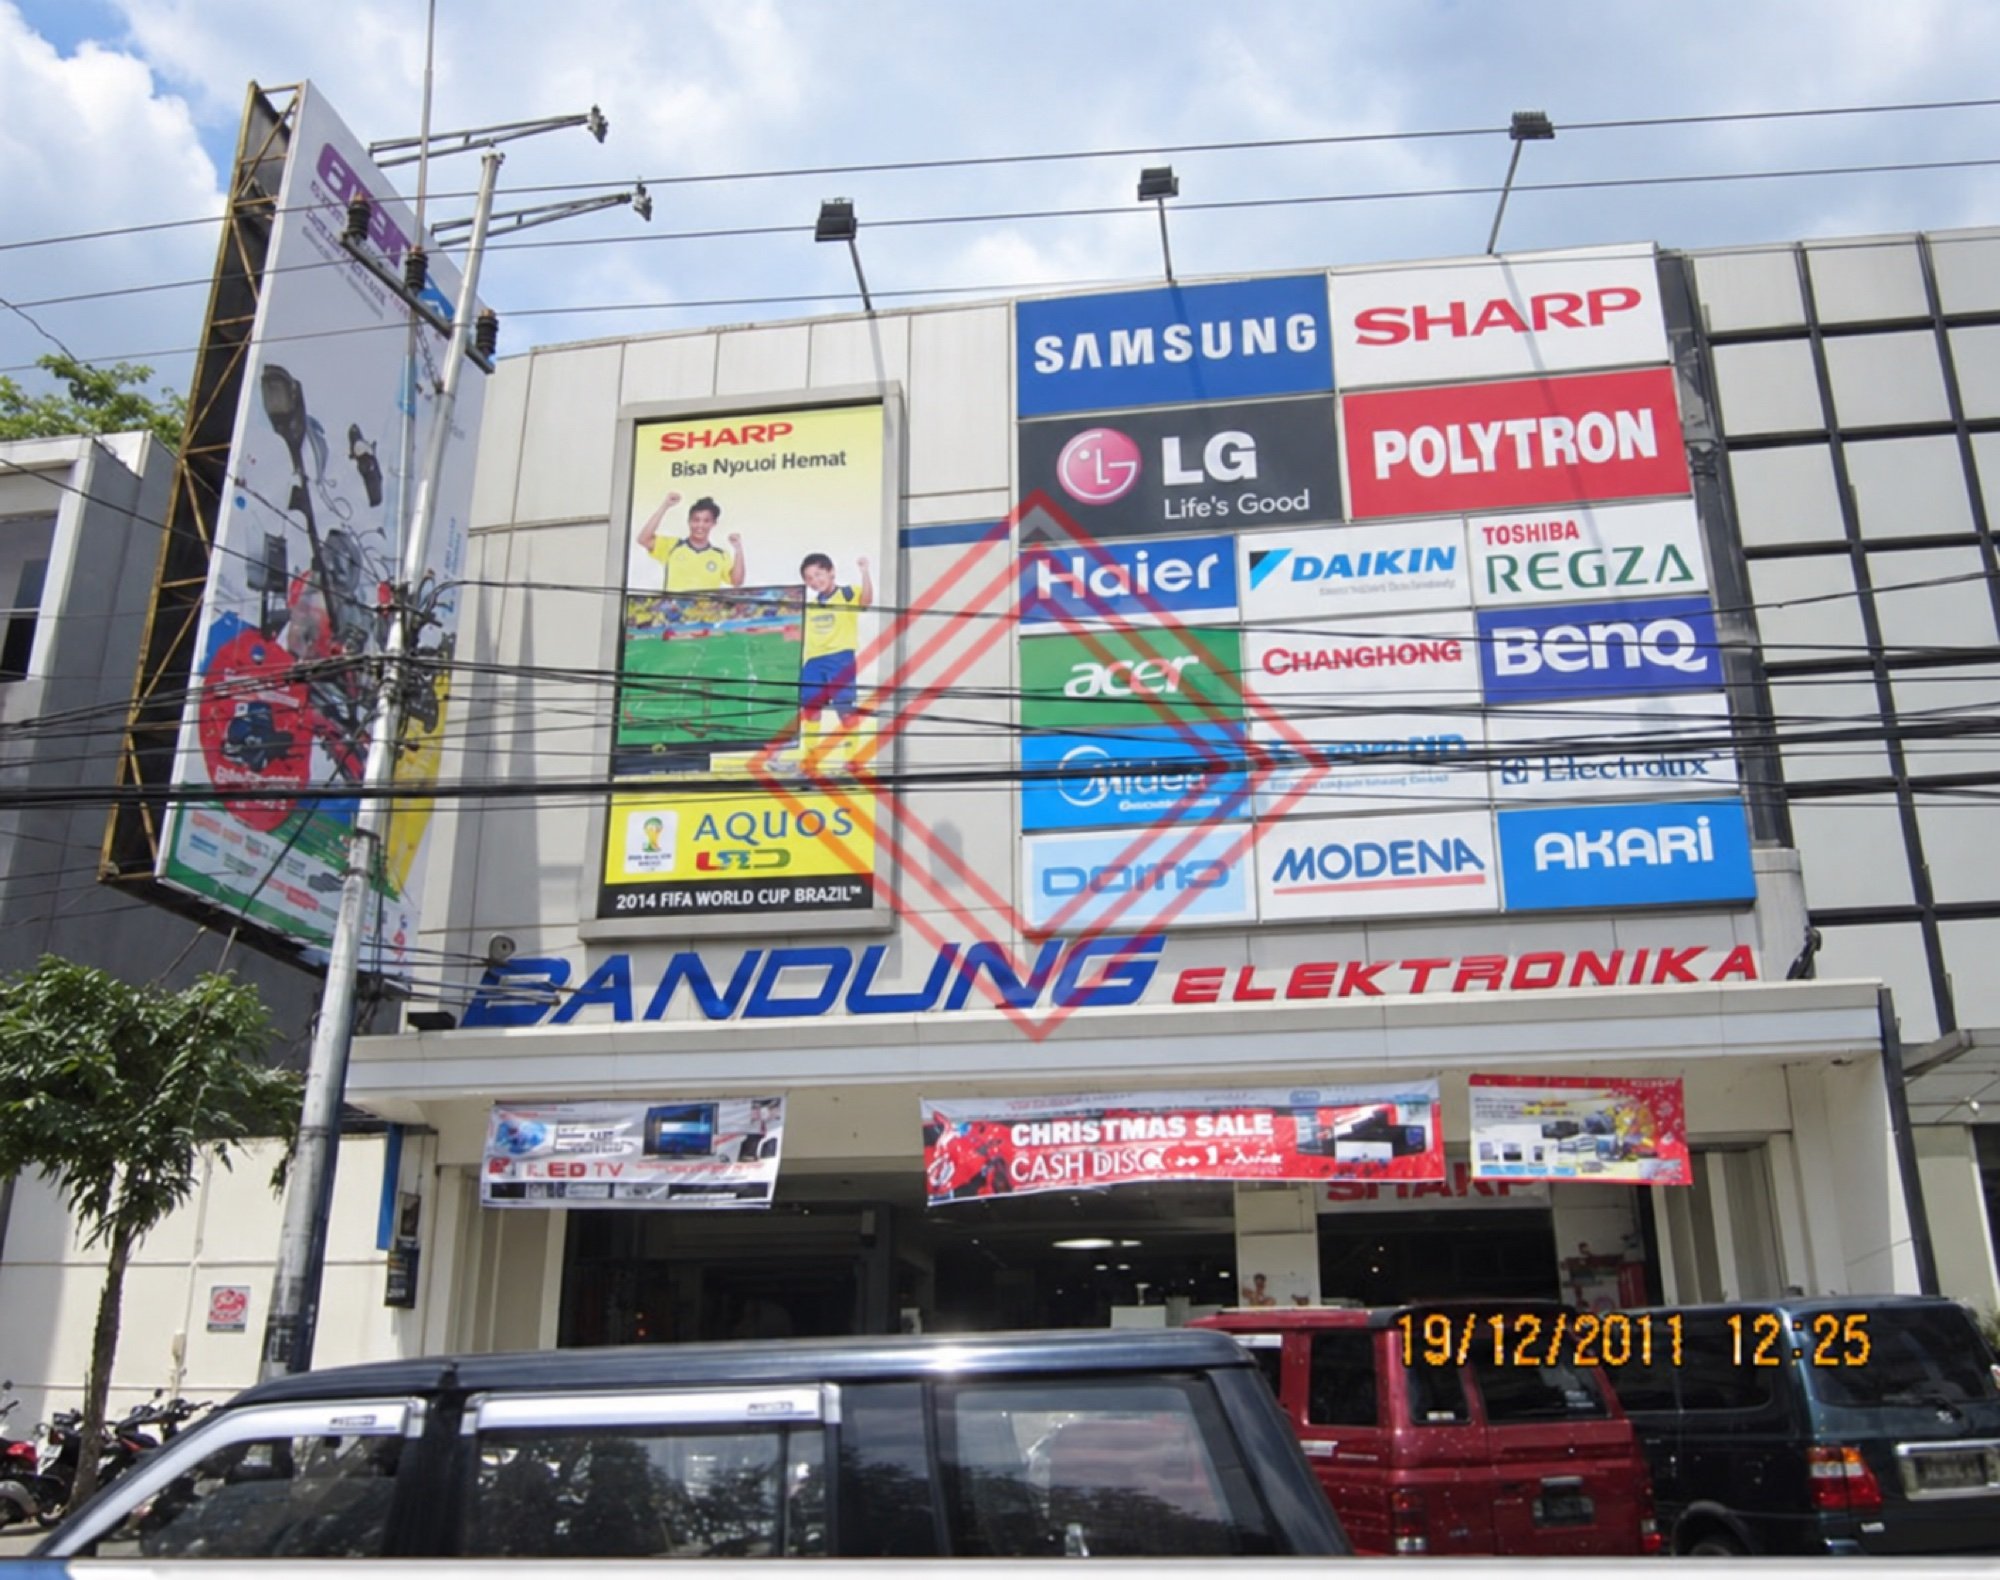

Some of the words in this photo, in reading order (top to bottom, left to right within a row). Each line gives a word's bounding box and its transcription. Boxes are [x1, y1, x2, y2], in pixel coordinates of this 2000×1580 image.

[1355, 287, 1642, 346] SHARP
[1033, 314, 1317, 374] SAMSUNG
[660, 422, 794, 452] SHARP
[1373, 408, 1658, 480] POLYTRON
[671, 460, 708, 478] Bisa
[782, 450, 847, 470] Hemat
[1161, 430, 1258, 486] LG
[1164, 496, 1230, 520] Life's
[1237, 488, 1311, 515] Good
[1482, 519, 1580, 545] TOSHIBA
[1036, 549, 1220, 600] Haier
[1291, 546, 1457, 582] DAIKIN
[1487, 543, 1694, 594] REGZA
[1063, 655, 1199, 698] acer
[692, 808, 854, 846] AQUOS
[1273, 838, 1485, 883] MODENA
[616, 893, 657, 910] 2014
[660, 890, 693, 908] FIFA
[695, 888, 754, 907] WORLD
[757, 886, 791, 905] CUP
[460, 934, 1166, 1028] BANDUNG
[1171, 944, 1759, 1005] ELEKTRONIKA
[1010, 1114, 1189, 1147] CHRISTMAS
[1195, 1111, 1274, 1138] SALE
[594, 1162, 625, 1178] TV
[1010, 1149, 1085, 1182] CASH
